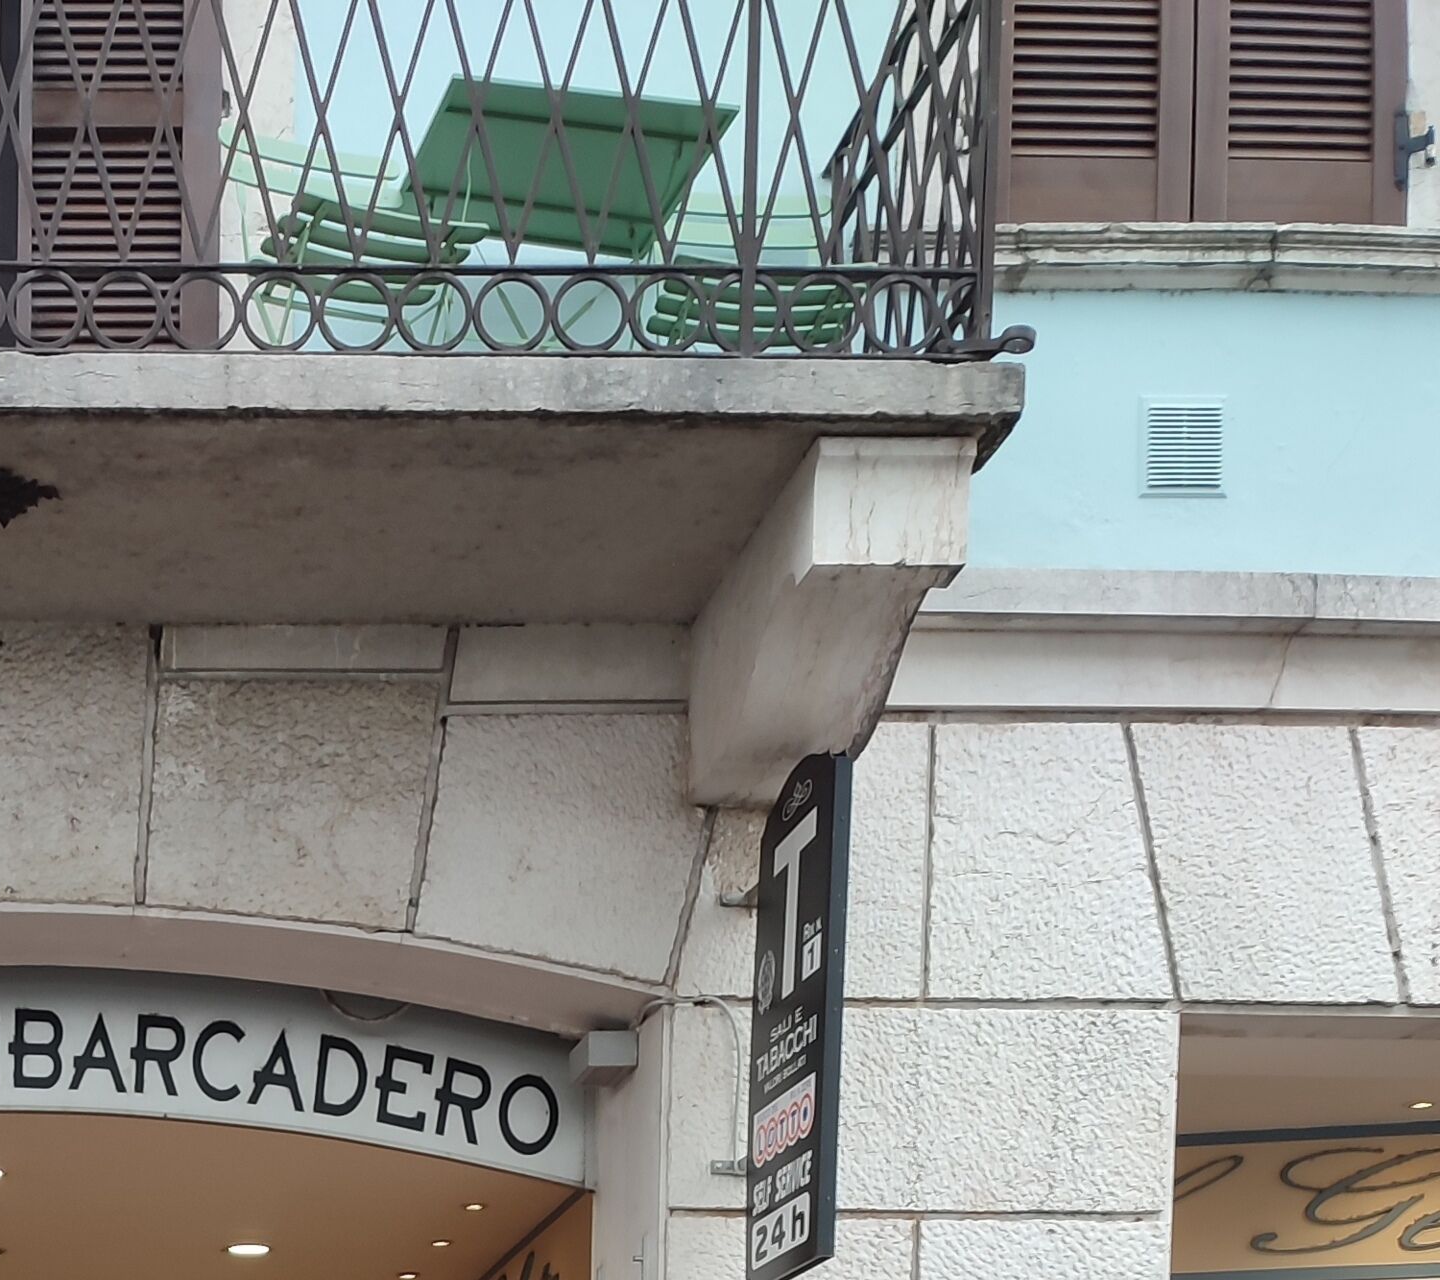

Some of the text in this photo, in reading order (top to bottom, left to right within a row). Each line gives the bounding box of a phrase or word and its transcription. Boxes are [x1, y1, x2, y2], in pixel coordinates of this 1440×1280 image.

[756, 1014, 818, 1082] TABACCHI
[794, 1006, 804, 1024] E
[755, 1098, 812, 1164] LOTTO
[752, 1149, 813, 1217] SELF SERVICE
